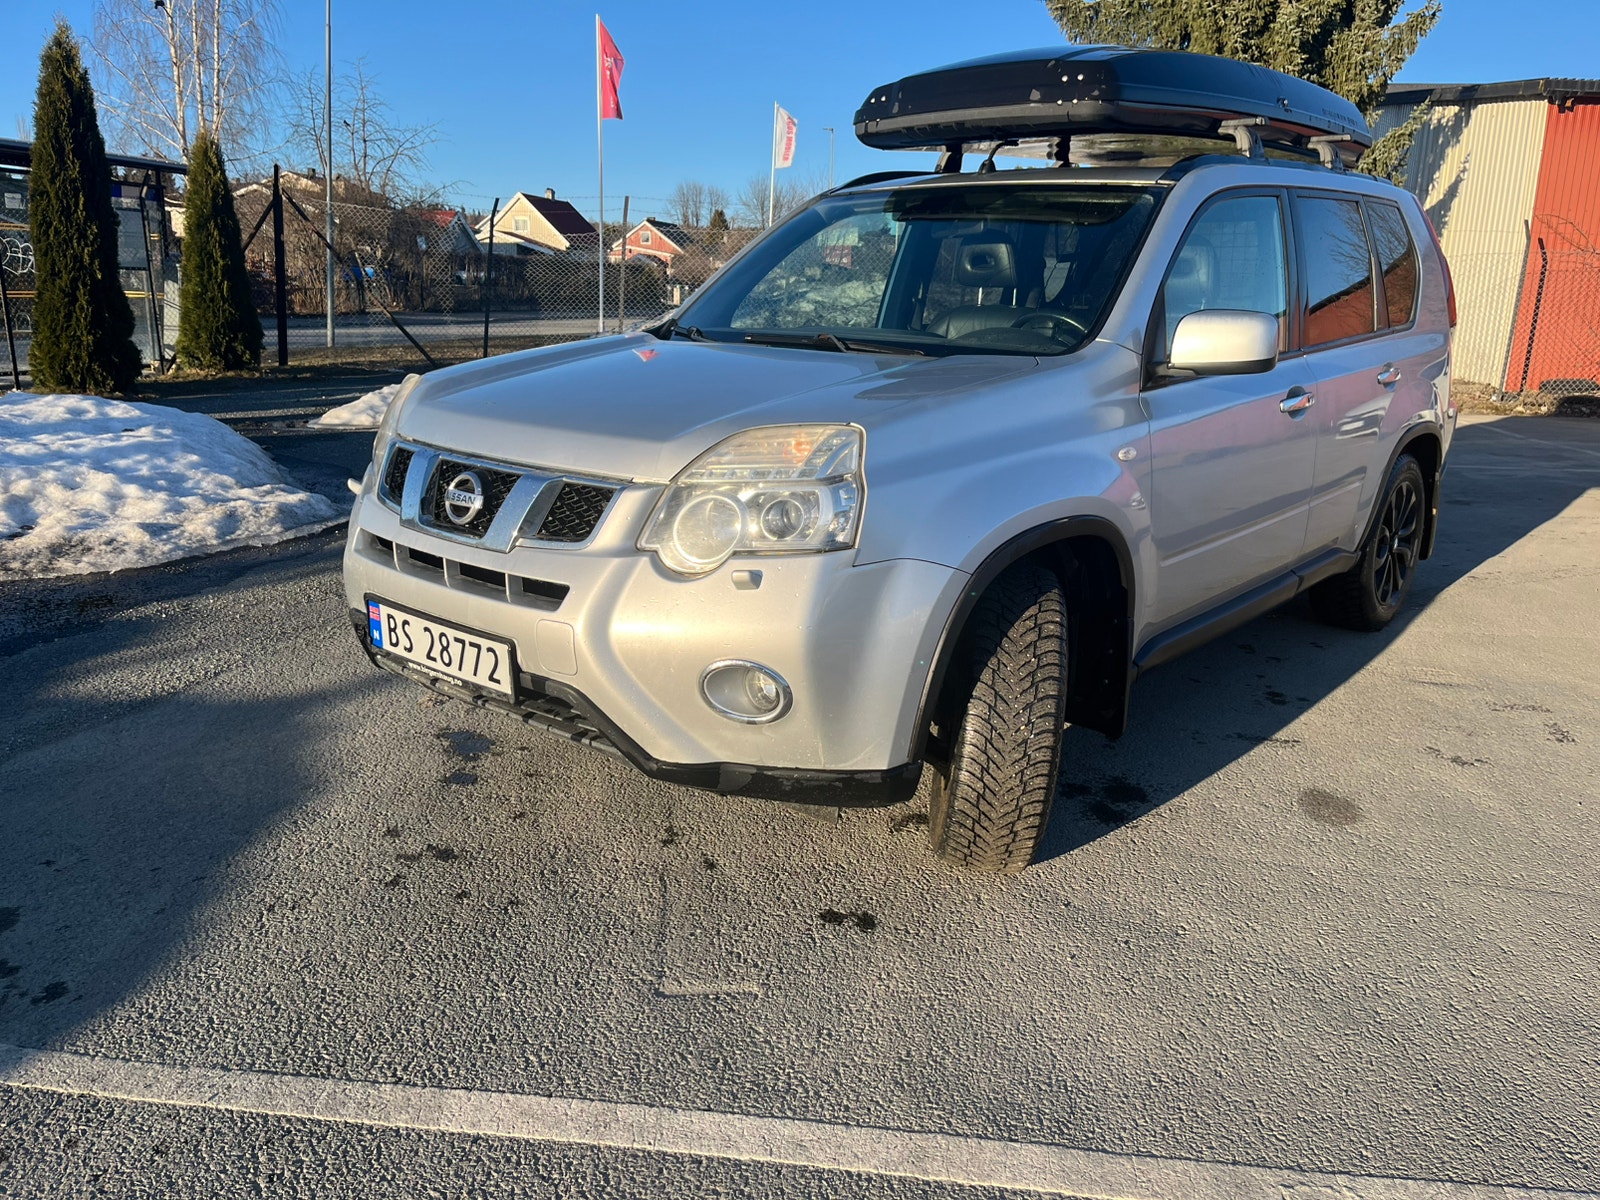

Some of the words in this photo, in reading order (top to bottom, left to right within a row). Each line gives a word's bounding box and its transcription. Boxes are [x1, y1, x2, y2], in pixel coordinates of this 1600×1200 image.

[373, 629, 380, 640] N
[387, 613, 413, 653] BS
[423, 626, 501, 685] 28772
